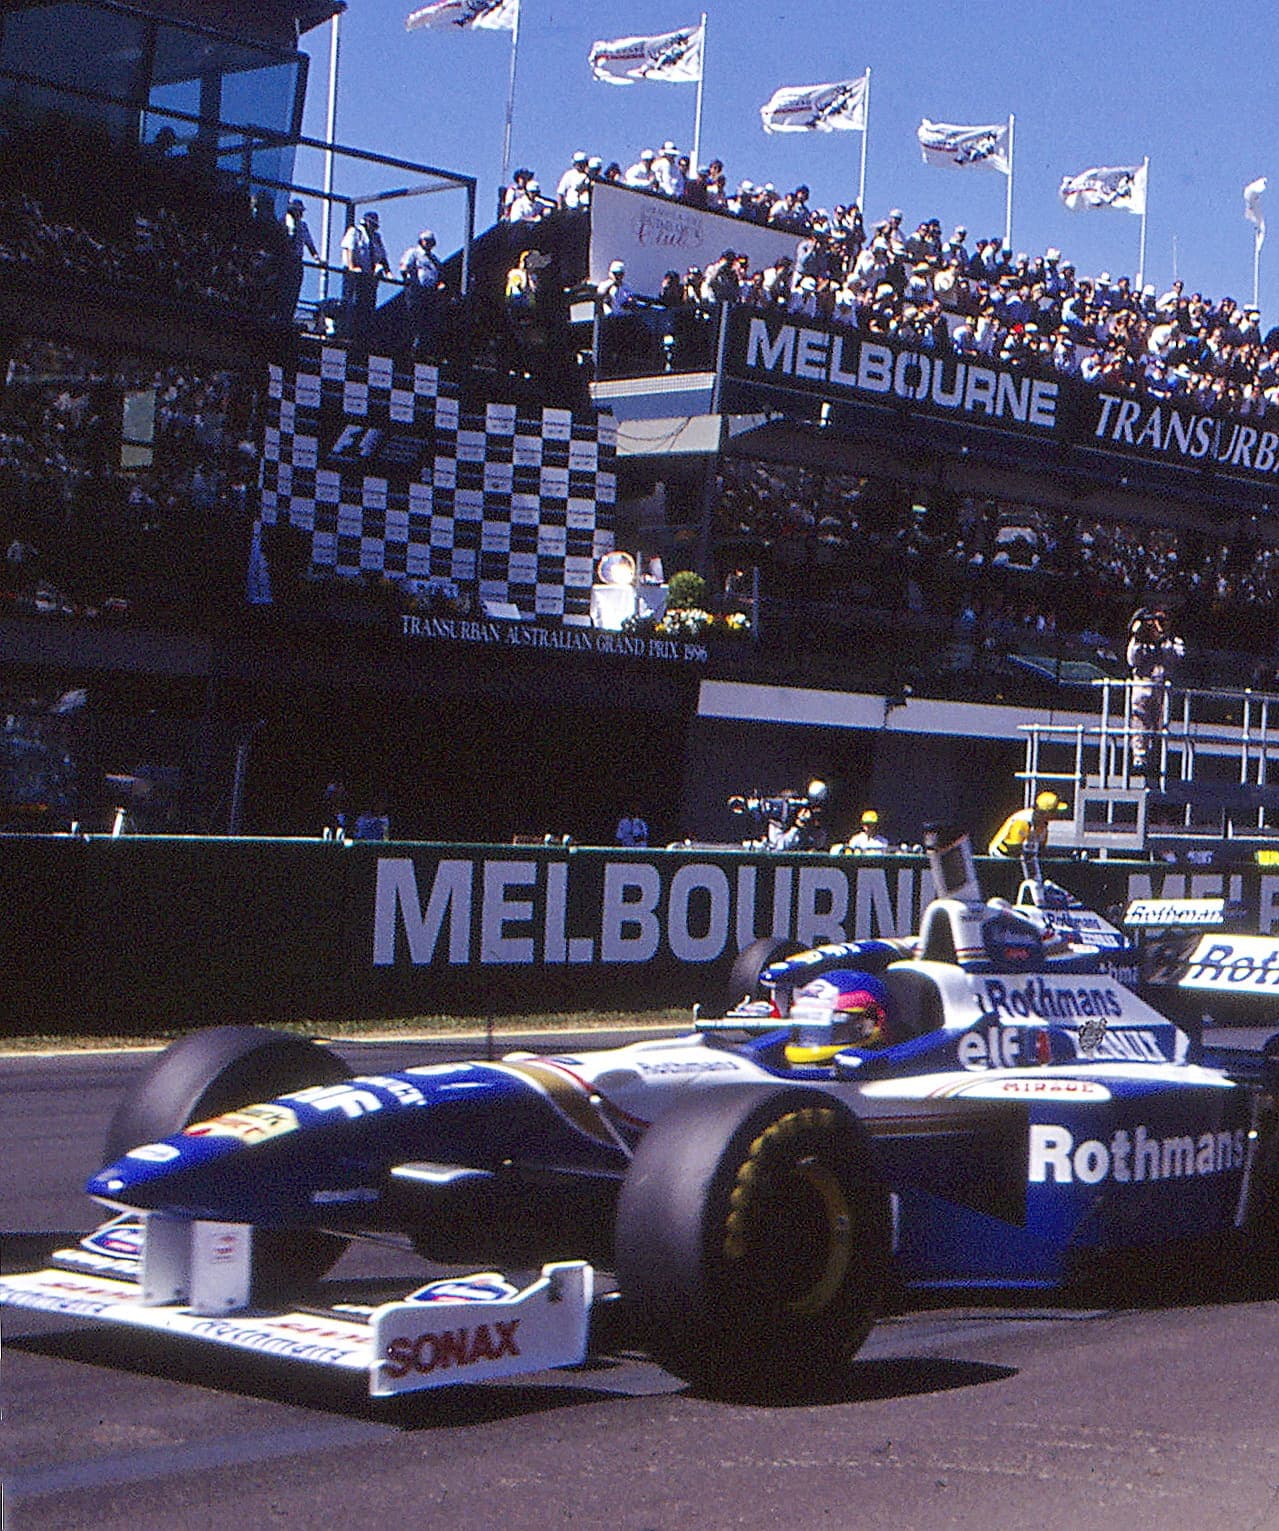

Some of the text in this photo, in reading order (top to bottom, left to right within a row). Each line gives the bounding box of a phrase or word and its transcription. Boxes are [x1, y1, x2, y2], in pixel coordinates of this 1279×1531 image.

[747, 318, 1059, 428] MELBOURNE
[507, 626, 592, 650] AUSTRALIAN
[373, 857, 937, 966] MELBOURN
[978, 976, 1122, 1019] Rothmans
[958, 1026, 1020, 1071] elf
[1029, 1124, 1246, 1183] Rothmans
[384, 1318, 521, 1378] SONAX
